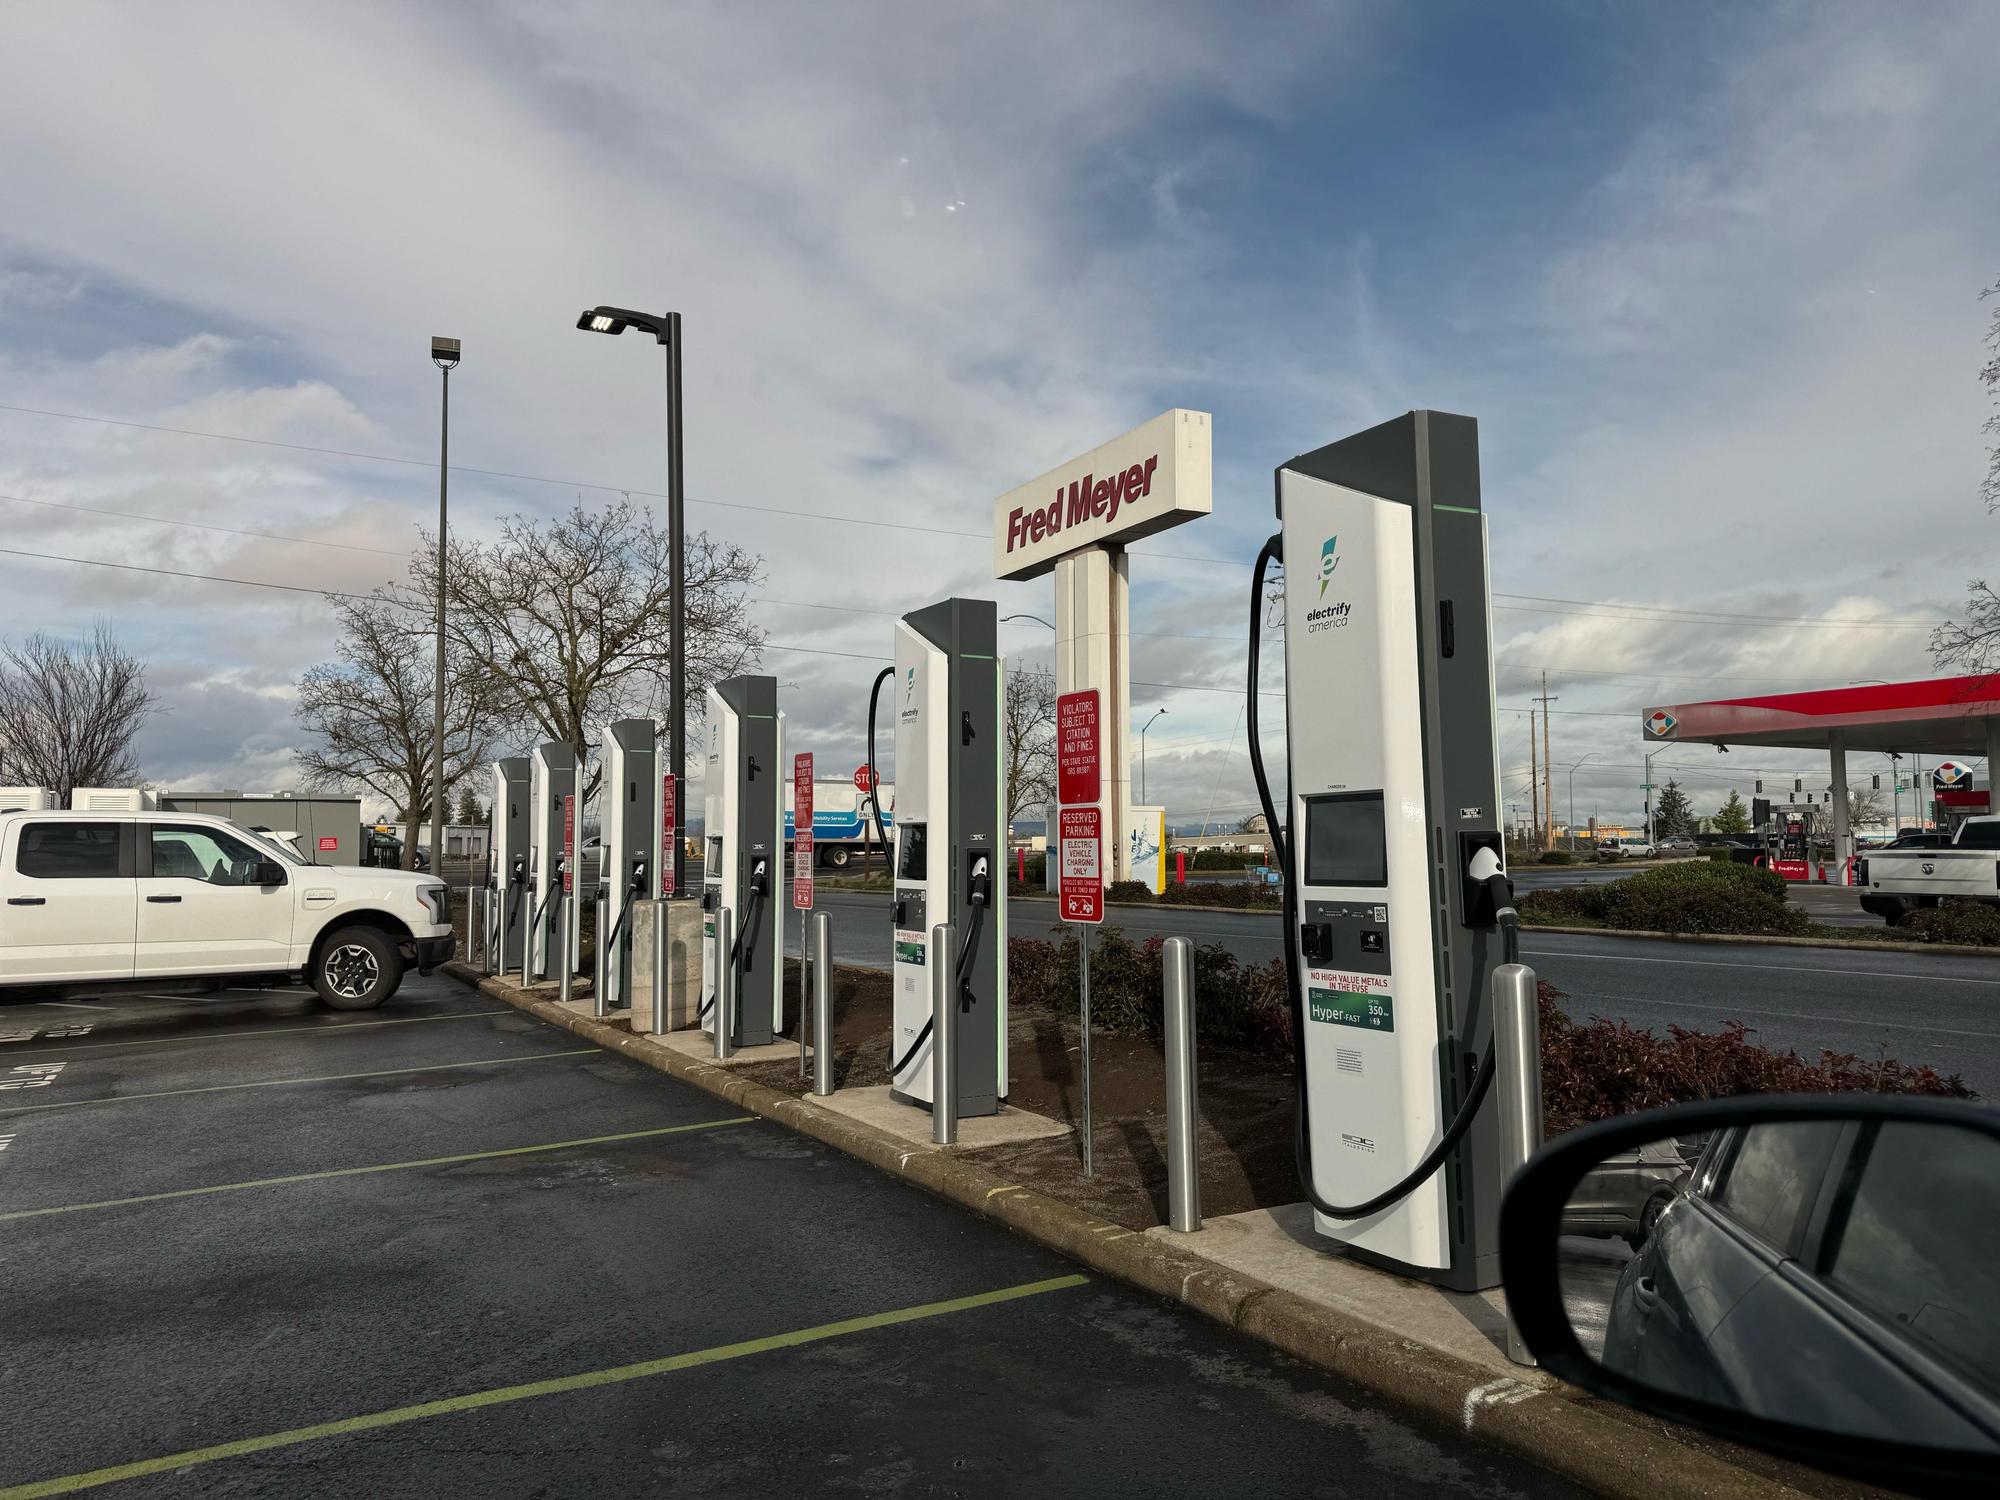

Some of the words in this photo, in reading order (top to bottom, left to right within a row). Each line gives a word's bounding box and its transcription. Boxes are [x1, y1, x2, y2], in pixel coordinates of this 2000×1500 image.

[1007, 487, 1064, 553] Fred
[1066, 454, 1158, 529] Meyer
[1307, 602, 1351, 621] electrify
[1308, 617, 1348, 634] america
[1062, 700, 1093, 715] VIOLATORS
[1062, 714, 1086, 728] SUBJECT
[1088, 713, 1095, 725] TO
[1066, 726, 1090, 740] CITATION
[1064, 742, 1076, 753] AND
[1077, 740, 1094, 752] FINES
[1063, 812, 1097, 824] RESERVED
[1066, 825, 1095, 836] PARKING
[1311, 972, 1320, 980] NO
[1322, 973, 1336, 982] HIGH
[1338, 975, 1360, 984] VALUE
[1361, 977, 1388, 987] METALS
[1338, 983, 1350, 991] THE
[1352, 984, 1368, 993] EVSE
[1368, 1004, 1383, 1016] 350
